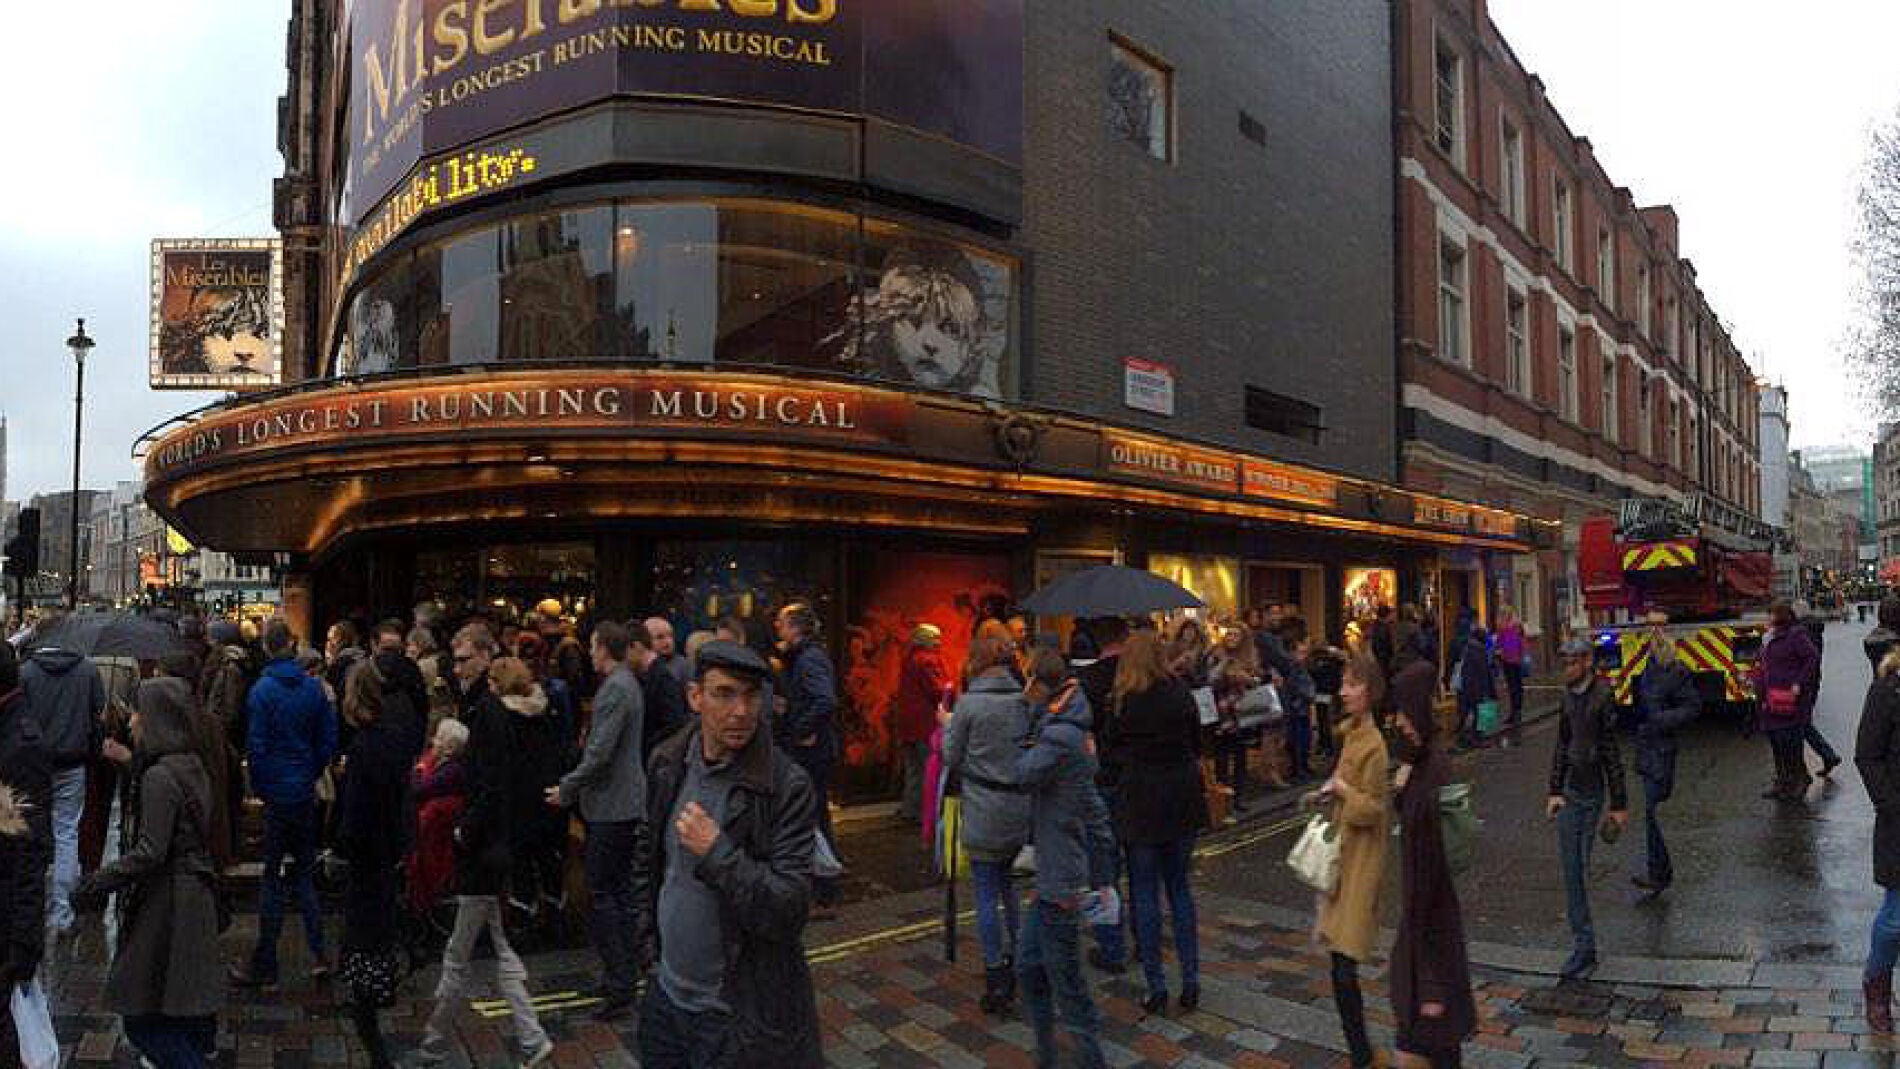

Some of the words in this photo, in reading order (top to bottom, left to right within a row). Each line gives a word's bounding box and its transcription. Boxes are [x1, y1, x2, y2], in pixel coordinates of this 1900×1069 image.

[439, 50, 545, 108] LONGEST
[554, 24, 685, 66] RUNNING
[697, 28, 832, 66] MUSICAL
[237, 399, 386, 445] LONGEST
[410, 387, 620, 423] RUNNING
[650, 390, 856, 429] MUSICAL
